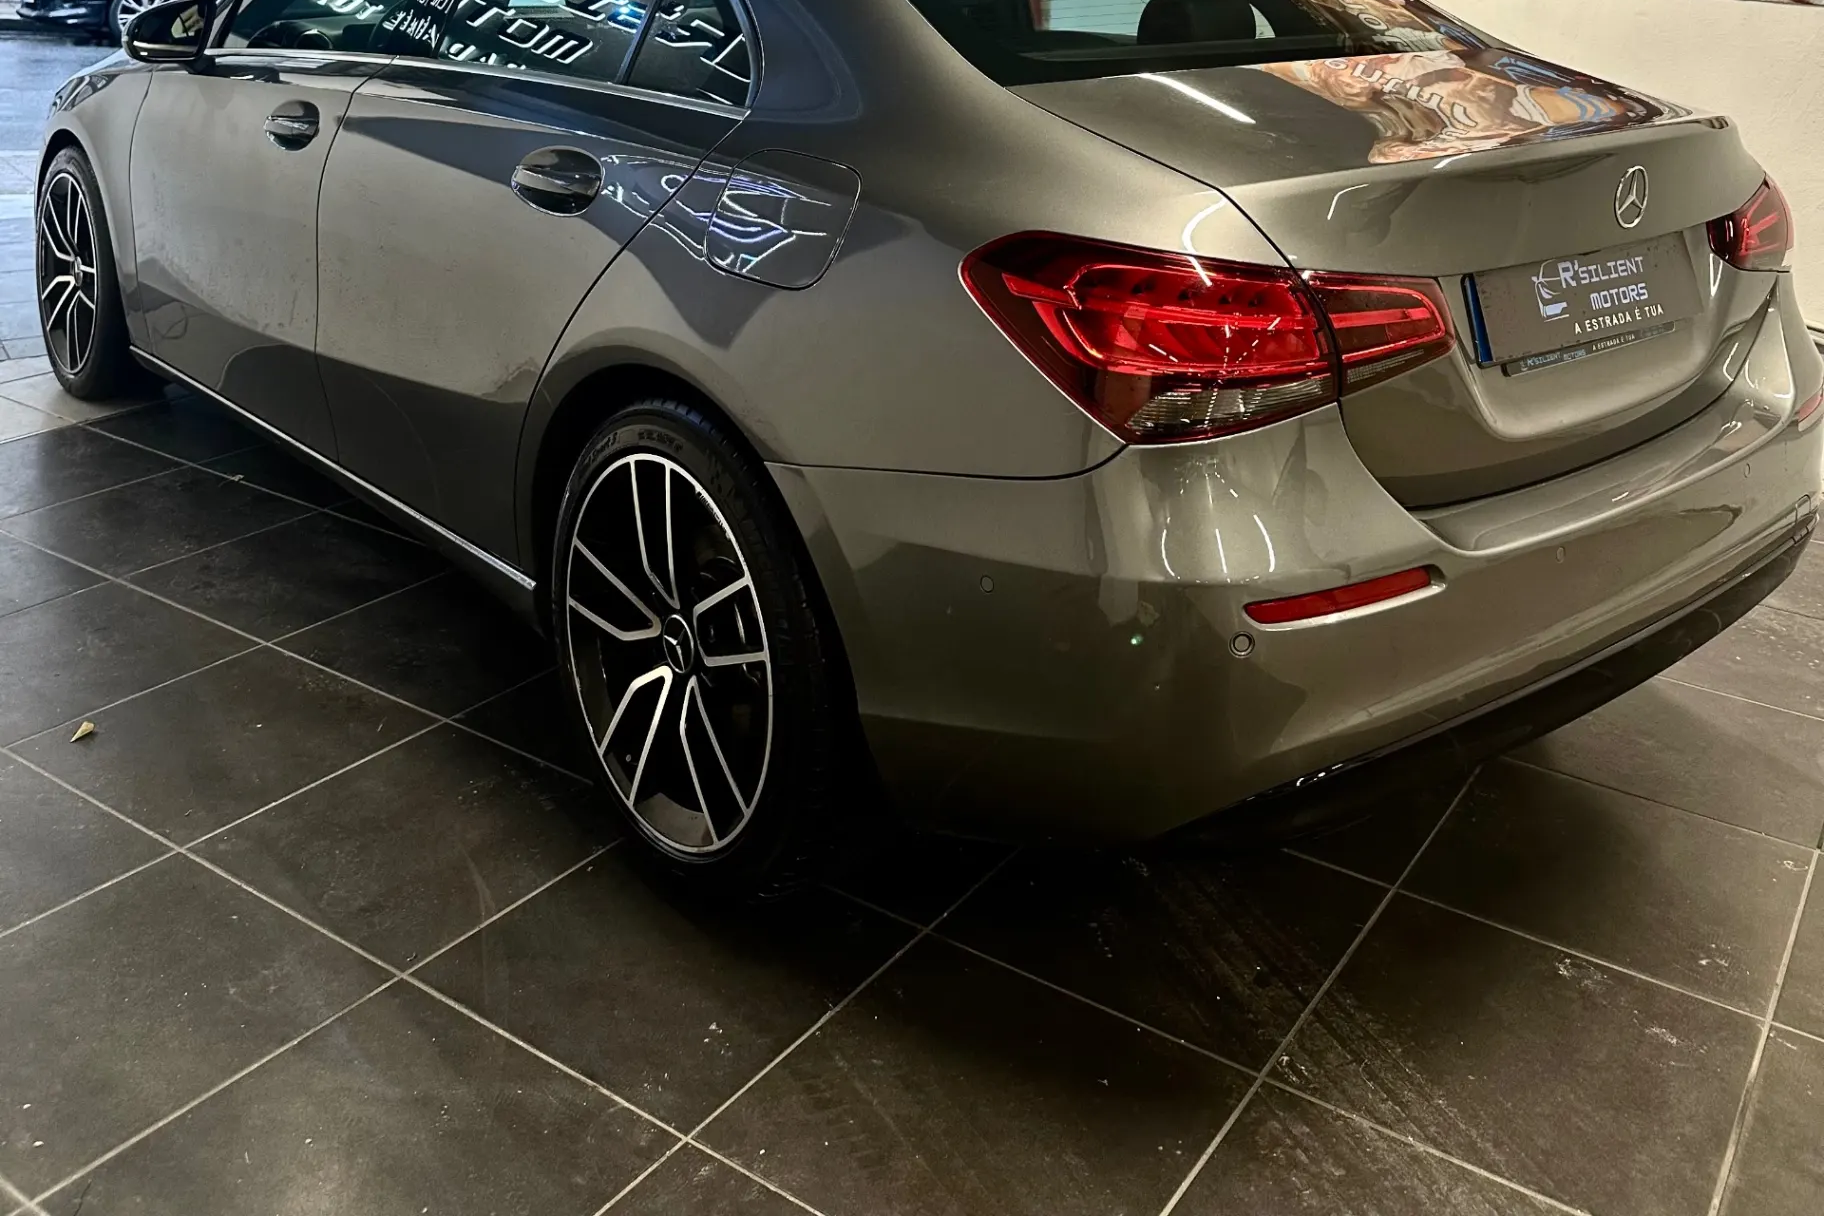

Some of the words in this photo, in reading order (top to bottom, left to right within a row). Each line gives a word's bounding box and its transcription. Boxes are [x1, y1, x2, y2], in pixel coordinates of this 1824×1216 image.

[1557, 256, 1644, 289] R'SILIENT
[1590, 282, 1649, 311] MOTORS
[1574, 322, 1582, 335] A
[1584, 311, 1633, 333] ESTRADA
[1635, 306, 1642, 321] É
[1644, 303, 1664, 318] TUA
